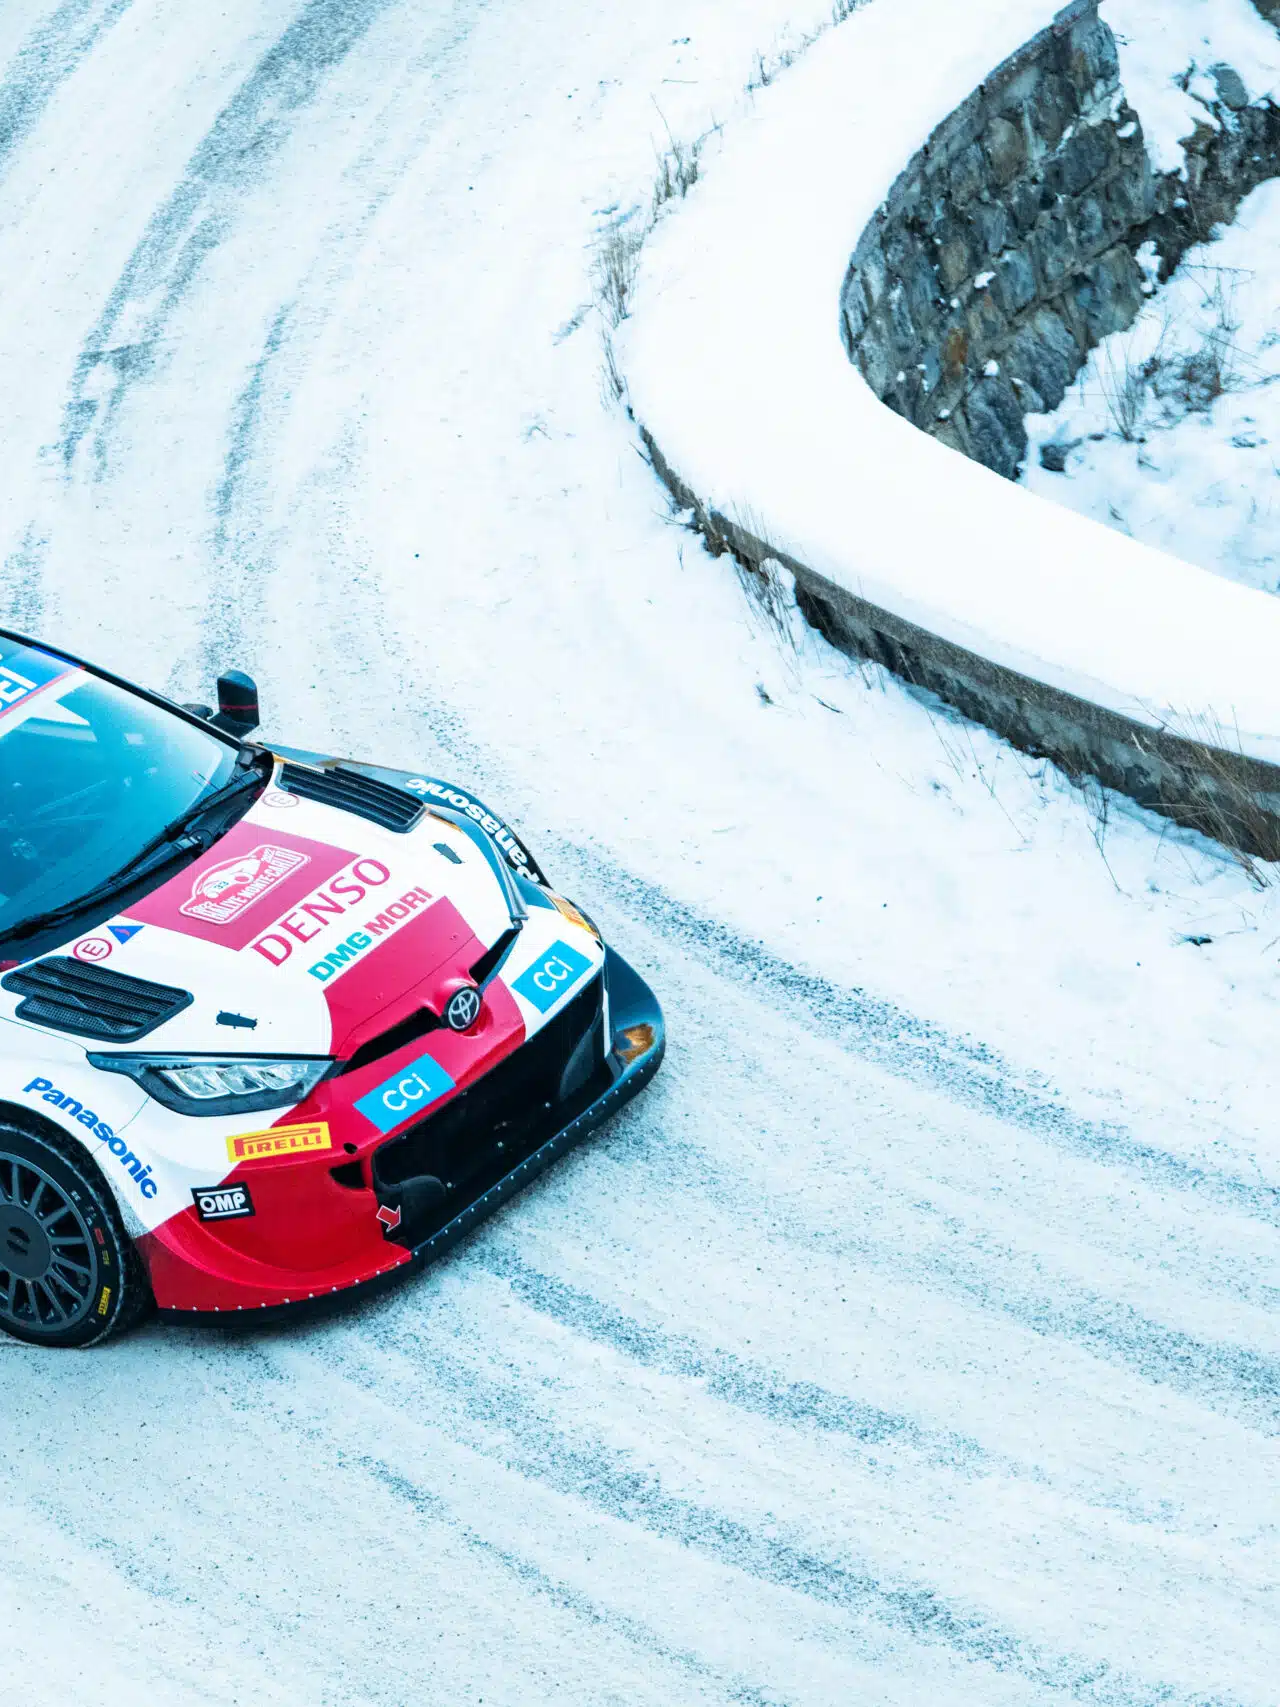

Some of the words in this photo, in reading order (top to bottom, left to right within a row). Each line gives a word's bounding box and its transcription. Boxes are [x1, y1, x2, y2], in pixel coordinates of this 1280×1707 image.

[251, 858, 391, 967] DENSO
[307, 931, 373, 982] DMG
[363, 886, 433, 936] MORI
[22, 1076, 158, 1199] Panasonic
[233, 1127, 322, 1157] PIRELLI
[199, 1191, 246, 1213] OMP
